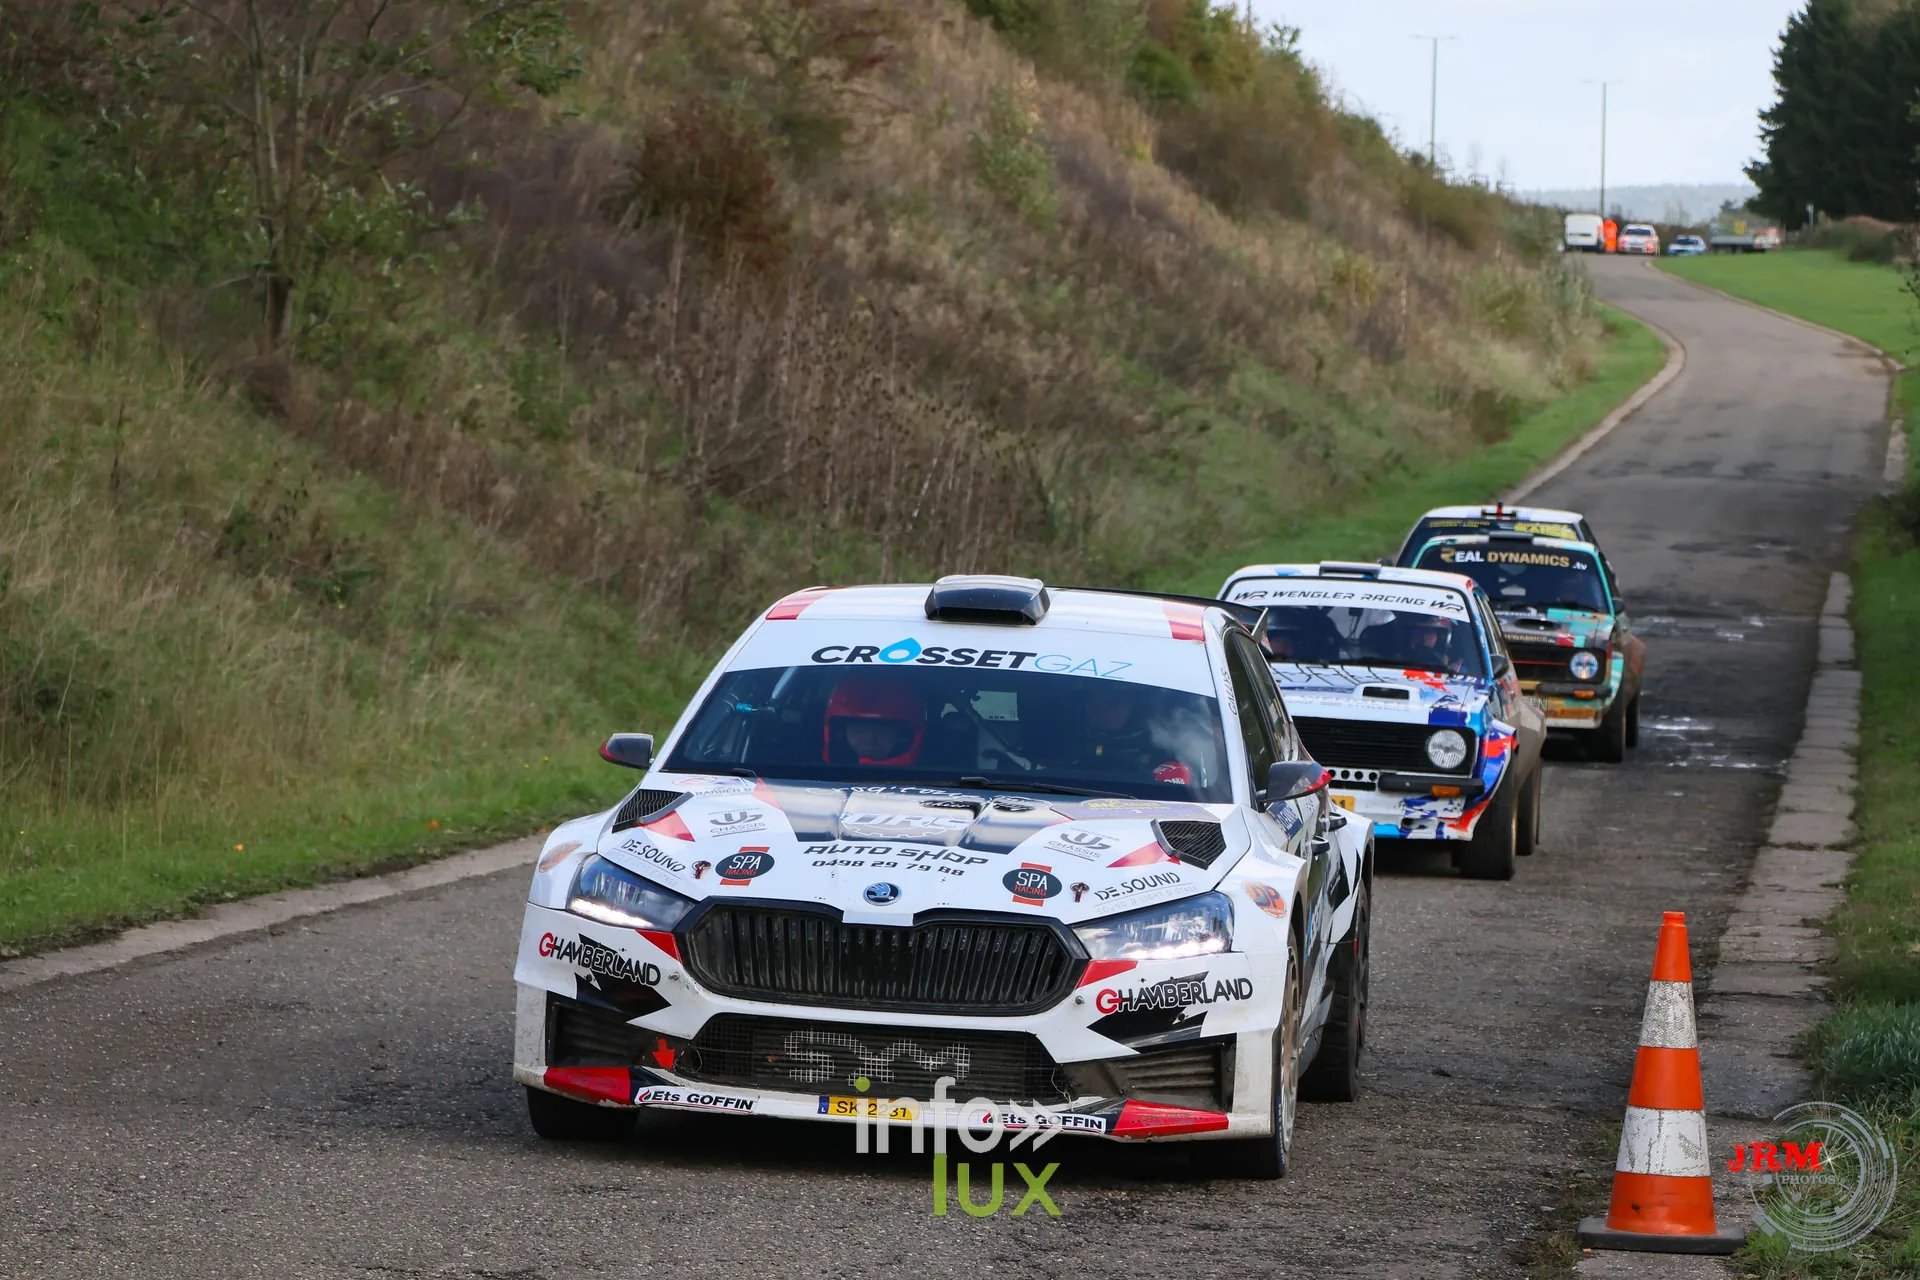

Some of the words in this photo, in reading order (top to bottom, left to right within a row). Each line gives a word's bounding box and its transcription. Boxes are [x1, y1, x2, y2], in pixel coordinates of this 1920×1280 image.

[1487, 552, 1570, 567] DYNAMICS
[1271, 591, 1355, 600] WENGLER
[1360, 593, 1426, 606] RACING
[728, 855, 762, 870] SPA
[896, 848, 989, 865] SHOP
[724, 867, 757, 876] RACING
[811, 858, 865, 867] 0498
[870, 860, 898, 869] 29
[905, 862, 932, 872] 79
[937, 864, 965, 876] 88
[1015, 871, 1049, 890] SPA
[1014, 884, 1047, 897] RACING
[651, 1089, 681, 1104] Ets
[686, 1093, 755, 1111] GOFFIN
